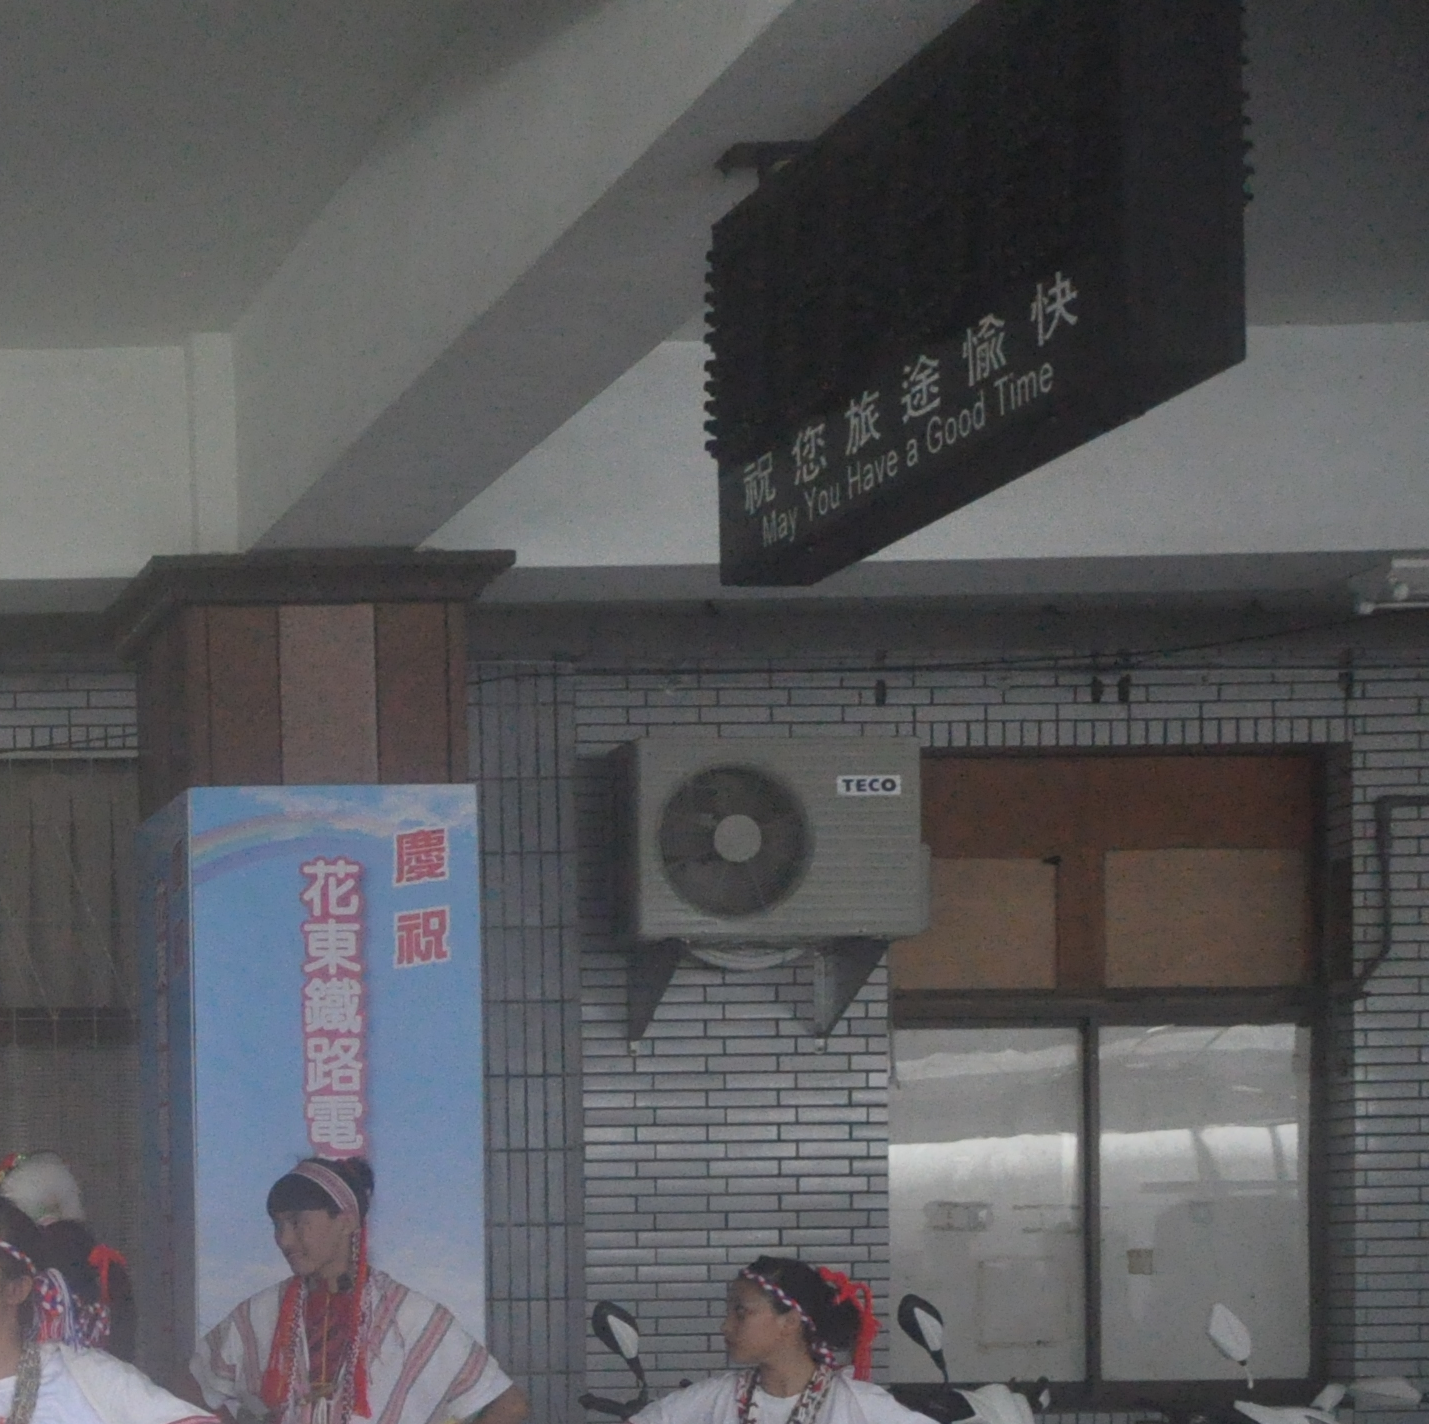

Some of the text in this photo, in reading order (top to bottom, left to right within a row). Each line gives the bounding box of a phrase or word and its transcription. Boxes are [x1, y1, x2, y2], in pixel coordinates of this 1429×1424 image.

[742, 270, 1079, 516] 祝您旅途愉快
[762, 361, 1054, 548] May You Have a Good Time
[842, 778, 897, 792] TECO
[393, 828, 450, 967] 慶祝
[302, 859, 364, 1159] 花東鐵路電
